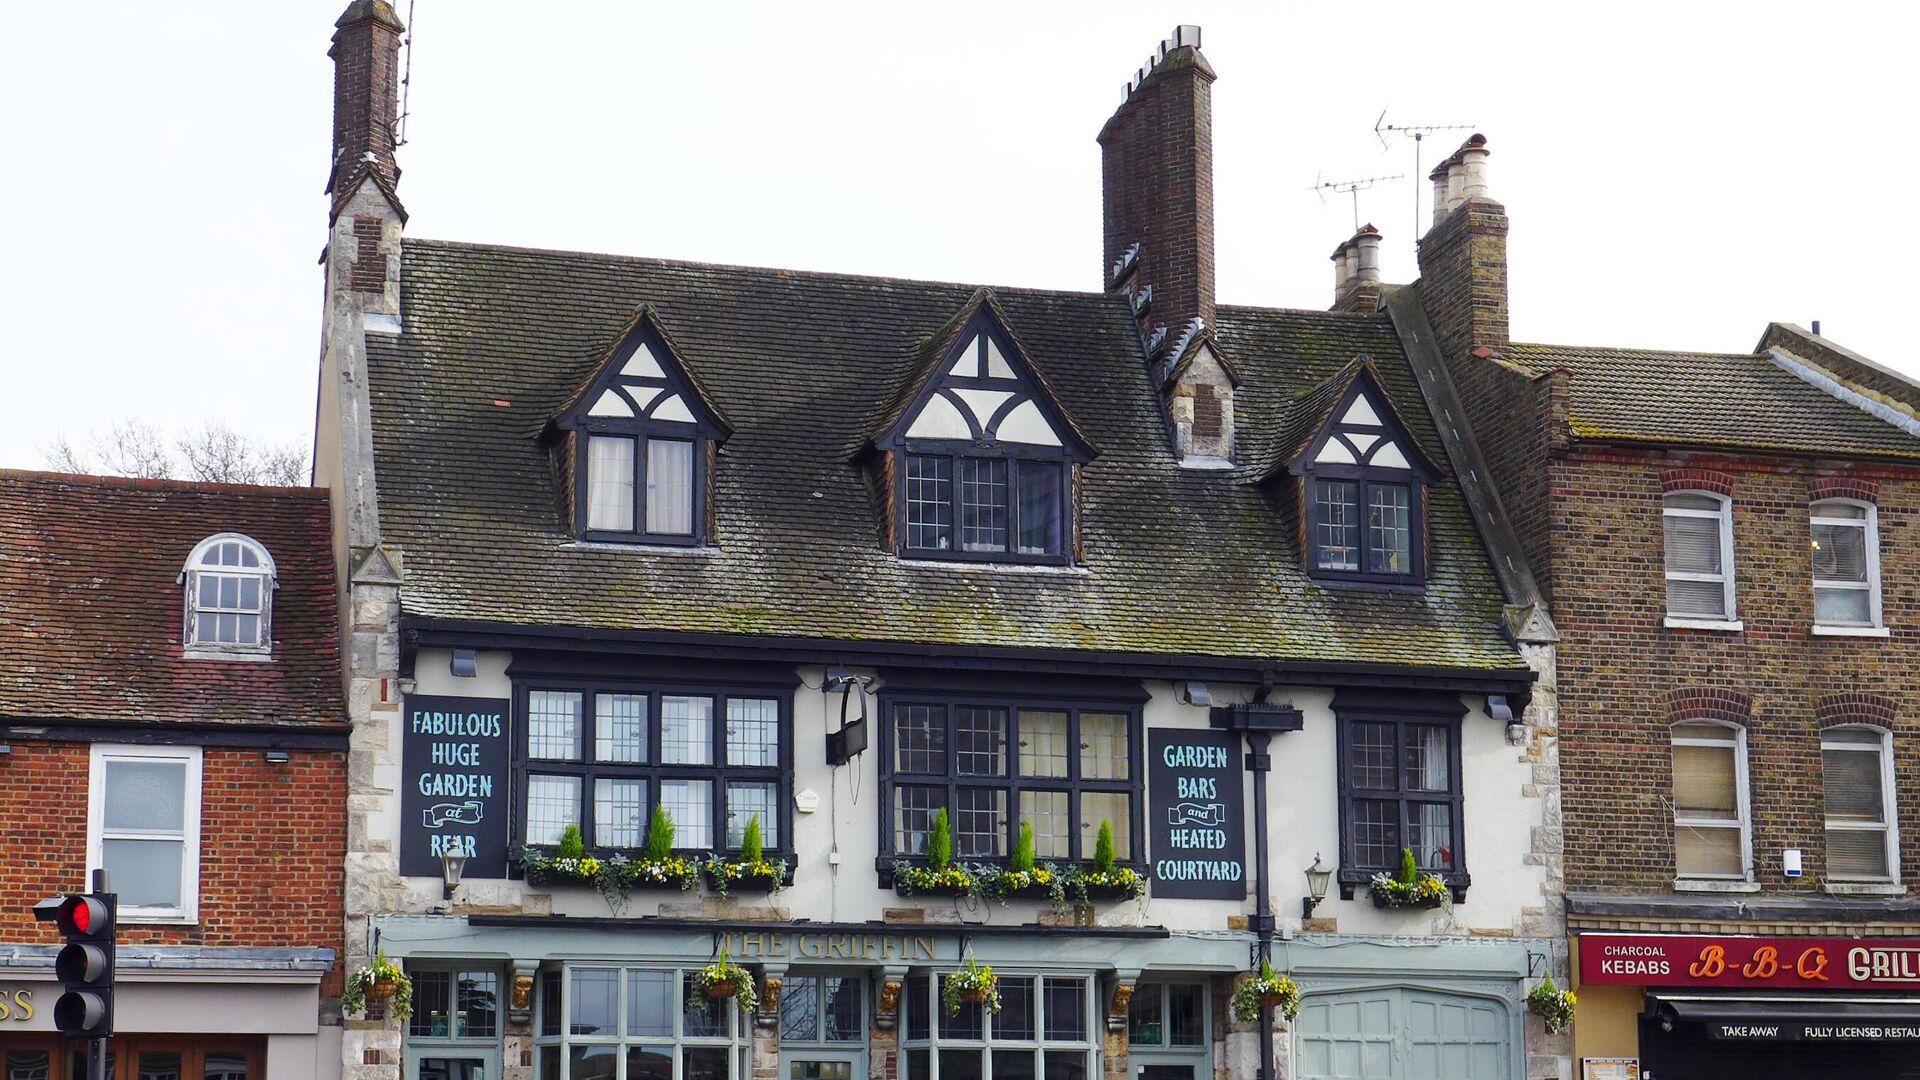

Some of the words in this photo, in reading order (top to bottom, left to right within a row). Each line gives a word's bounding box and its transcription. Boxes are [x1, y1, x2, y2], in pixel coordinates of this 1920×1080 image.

[413, 712, 501, 737] FABULOUS
[432, 743, 480, 766] HUGE
[1163, 745, 1228, 768] GARDEN
[419, 773, 492, 798] GARDEN
[1177, 777, 1217, 800] BARS
[445, 808, 463, 819] at
[1187, 808, 1209, 820] and
[1170, 829, 1226, 849] HEATED
[1156, 860, 1242, 882] COURTYARD
[719, 931, 790, 957] THE
[799, 933, 936, 960] GRIFFIN
[1604, 945, 1666, 957] CHARCOAL
[1601, 960, 1670, 975] KEBABS
[1689, 945, 1829, 980] B-B-Q
[1848, 947, 1920, 981] GRIL
[1721, 1026, 1748, 1037] TAKE
[1749, 1027, 1779, 1037] AWAY
[1805, 1027, 1834, 1038] FULLY
[1836, 1028, 1883, 1038] LICENSED
[1884, 1028, 1920, 1038] RESTAU
